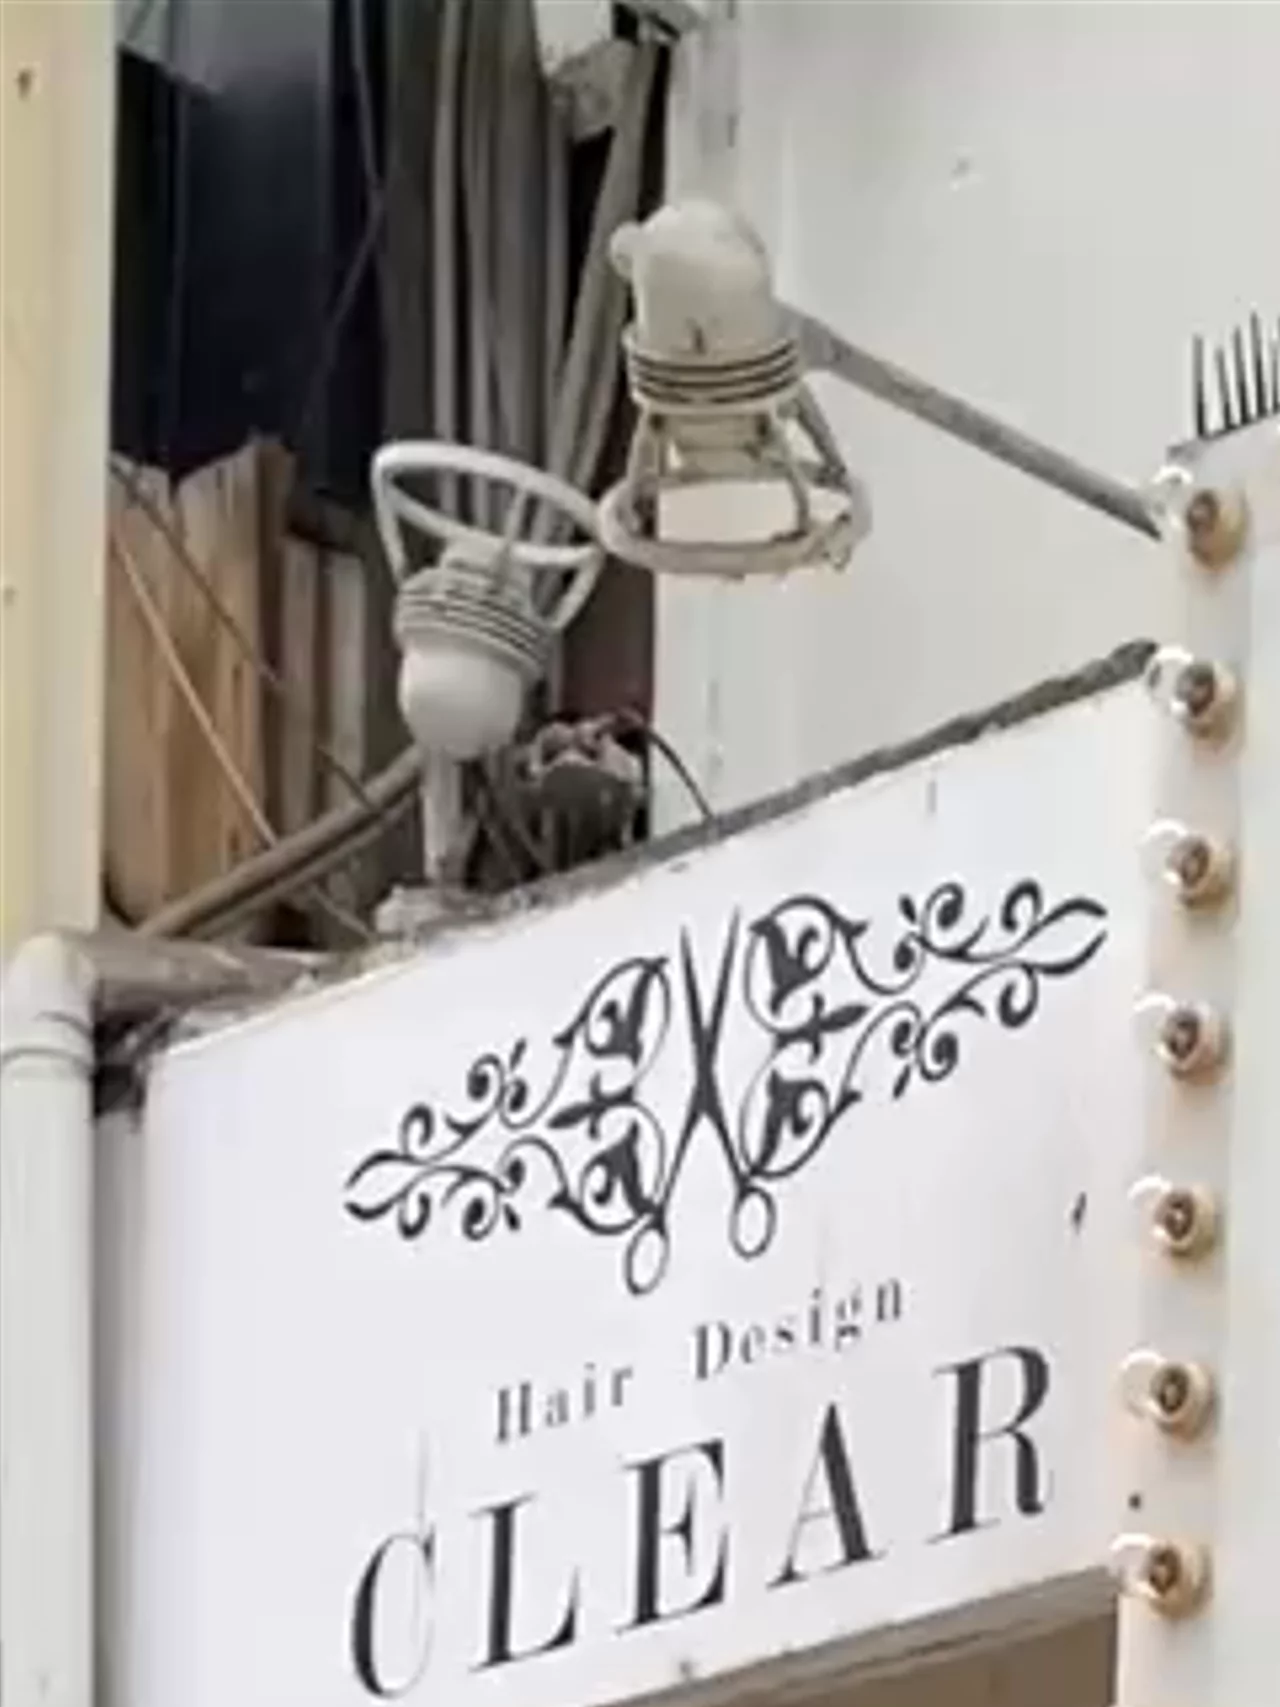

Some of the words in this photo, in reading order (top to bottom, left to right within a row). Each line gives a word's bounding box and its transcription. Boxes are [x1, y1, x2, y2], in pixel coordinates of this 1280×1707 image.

[493, 1360, 634, 1447] Hair
[690, 1273, 906, 1384] Design
[348, 1344, 1056, 1702] CLEAR
